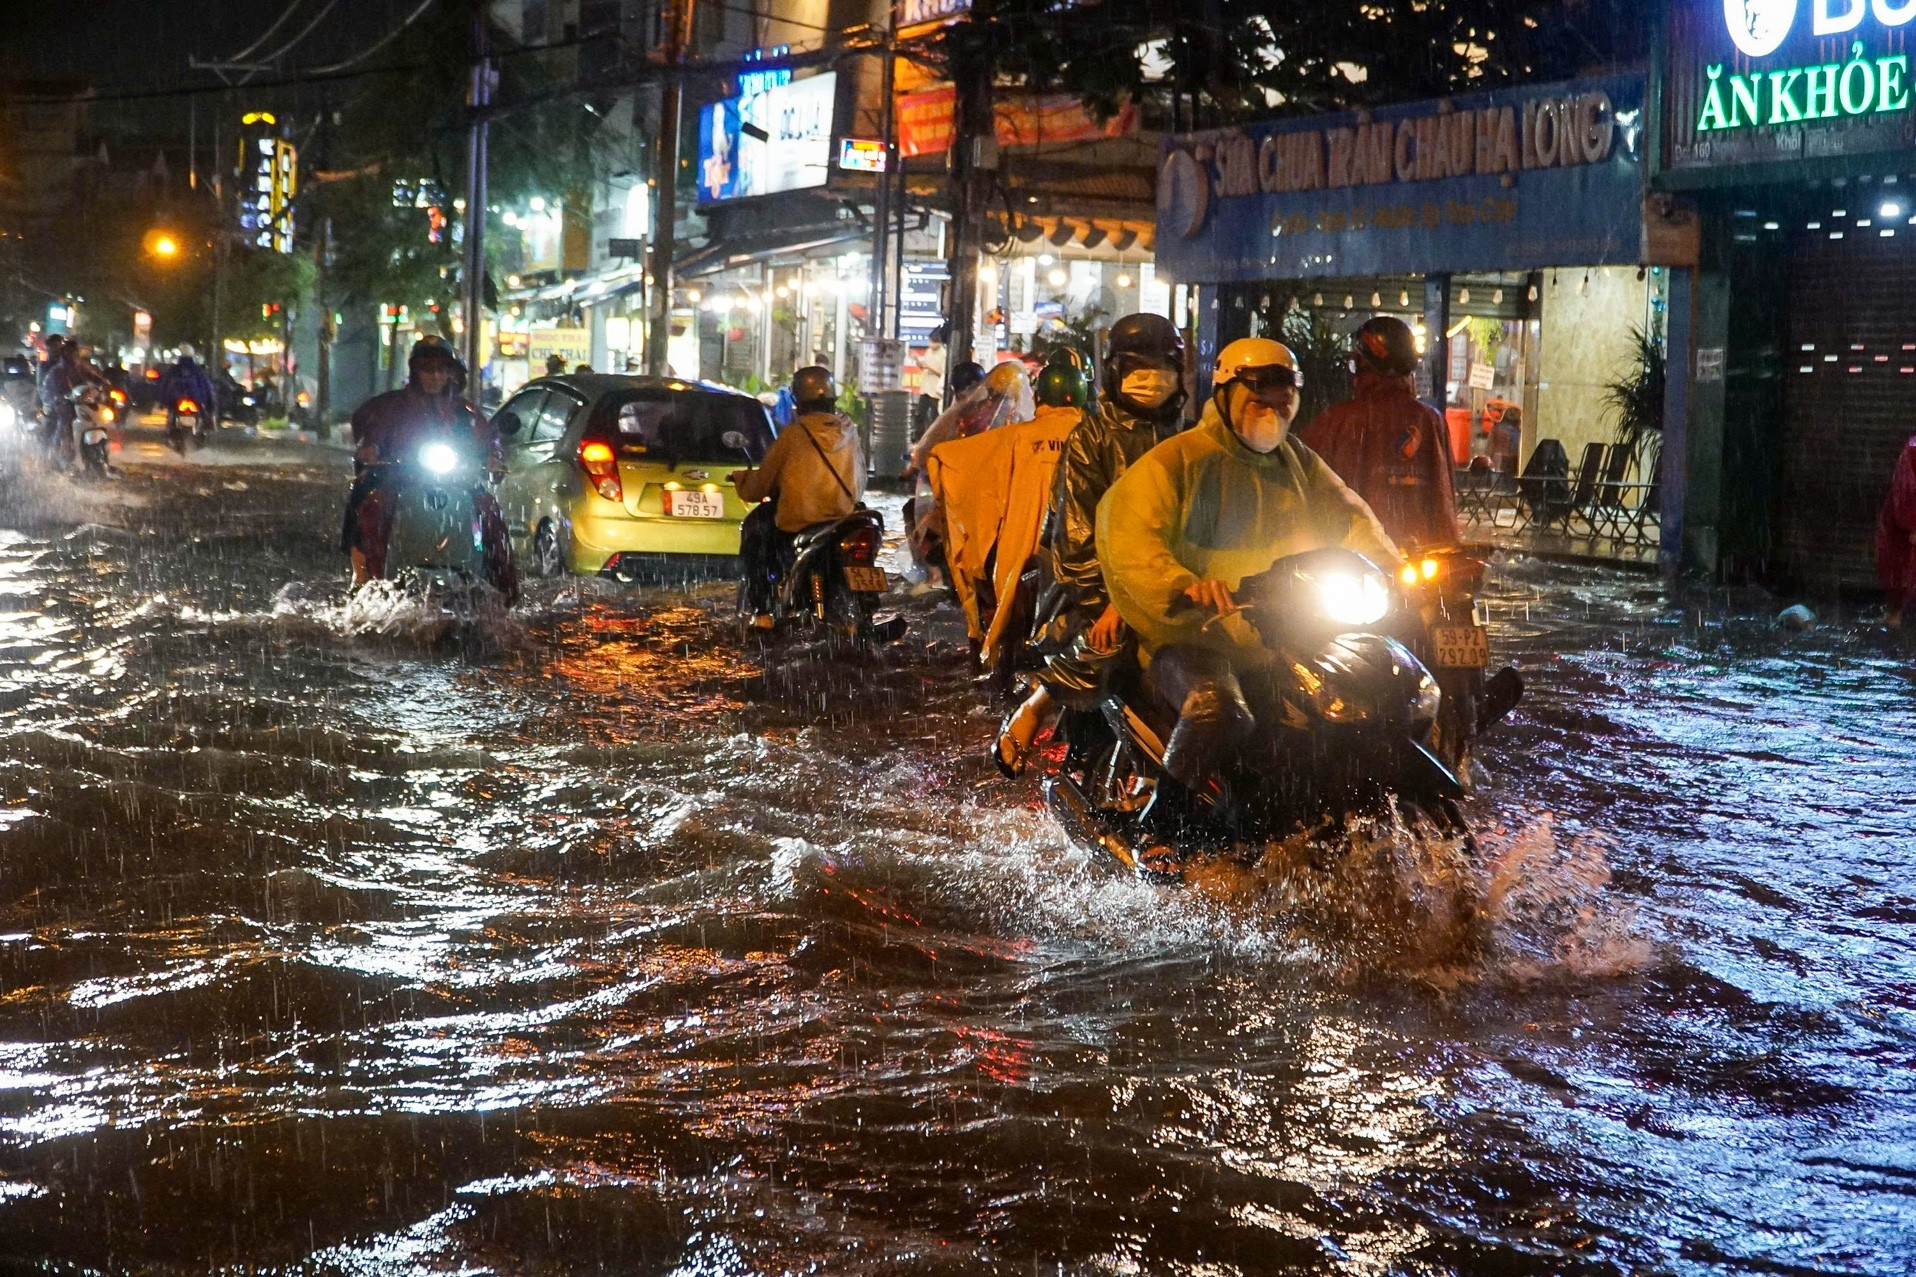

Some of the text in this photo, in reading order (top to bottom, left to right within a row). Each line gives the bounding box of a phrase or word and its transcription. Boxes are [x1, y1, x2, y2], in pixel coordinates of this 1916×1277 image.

[1697, 40, 1909, 131] ĂN KHỎE
[1259, 130, 1327, 194] CHUA
[1475, 105, 1521, 188] HẠ
[1522, 91, 1614, 171] LONG
[677, 504, 718, 516] 578.57
[686, 492, 708, 504] 49A
